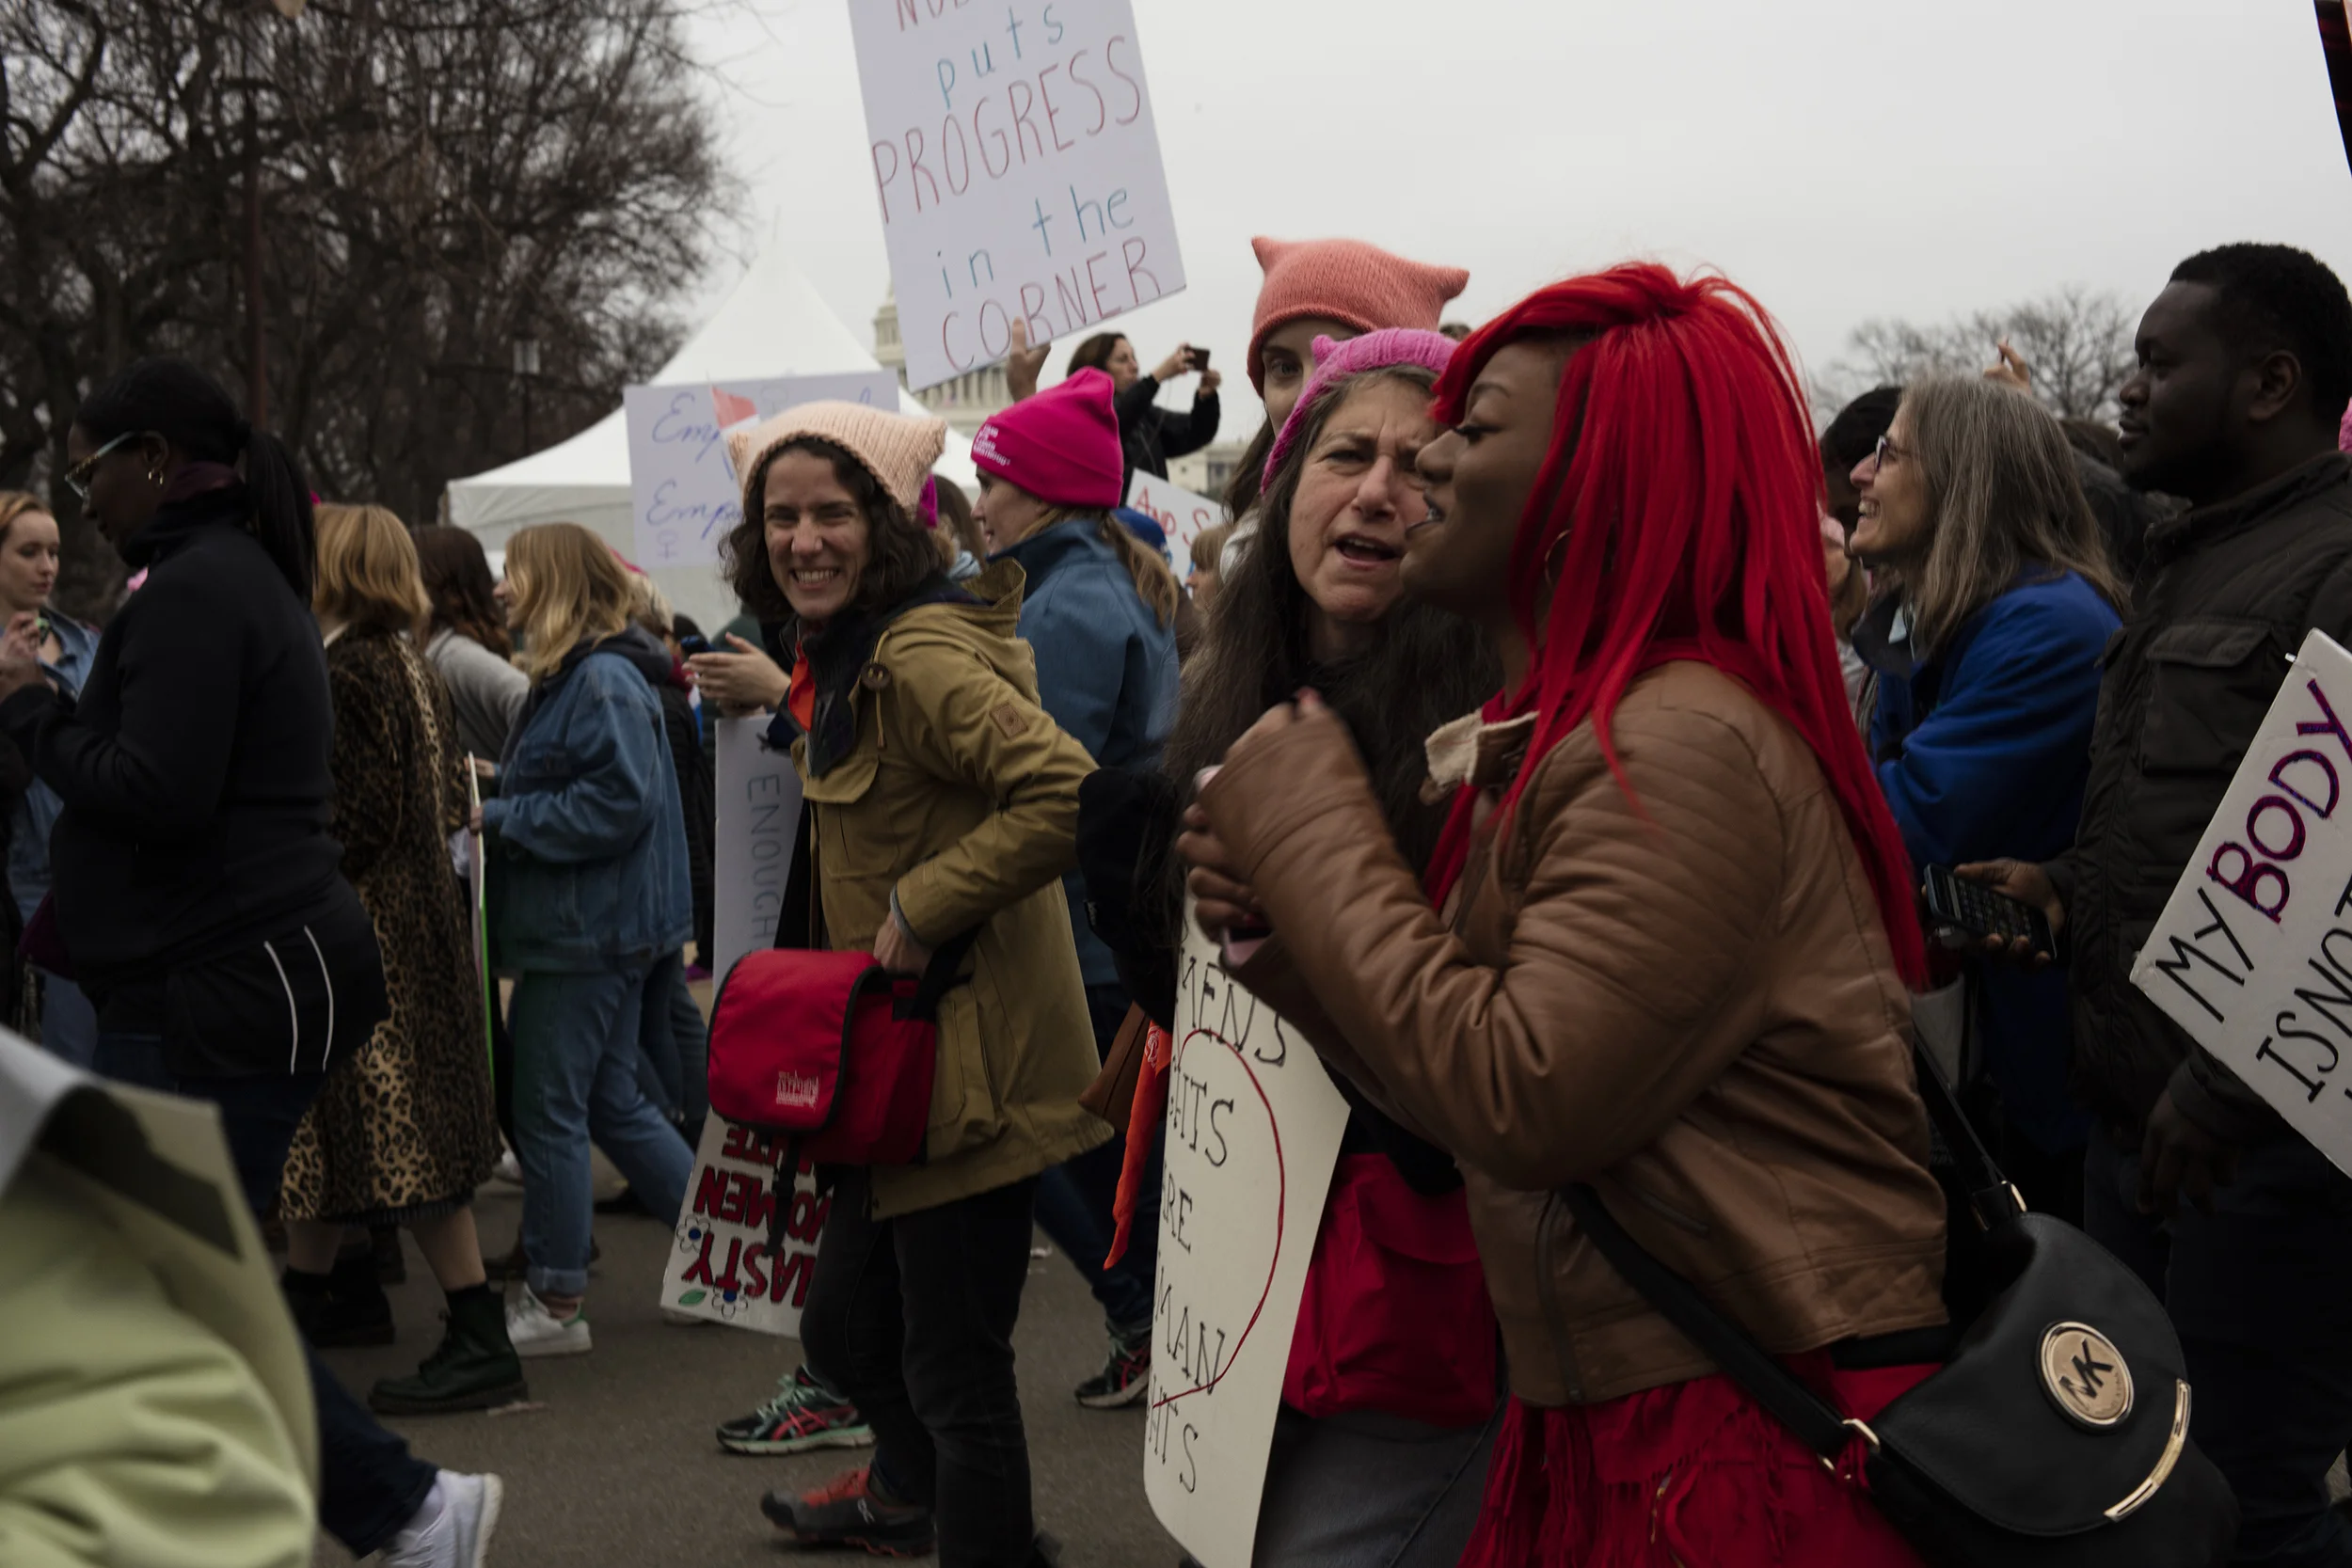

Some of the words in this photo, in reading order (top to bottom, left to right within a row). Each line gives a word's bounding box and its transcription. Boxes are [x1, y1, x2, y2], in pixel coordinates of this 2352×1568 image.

[937, 3, 1063, 110] puts
[872, 35, 1141, 225] PROGRESS
[937, 248, 994, 299] in
[1032, 183, 1135, 258] the
[942, 235, 1162, 372] CORNER
[2154, 886, 2255, 1023] MY
[2205, 678, 2352, 926] BODY
[2058, 1338, 2115, 1412] MK
